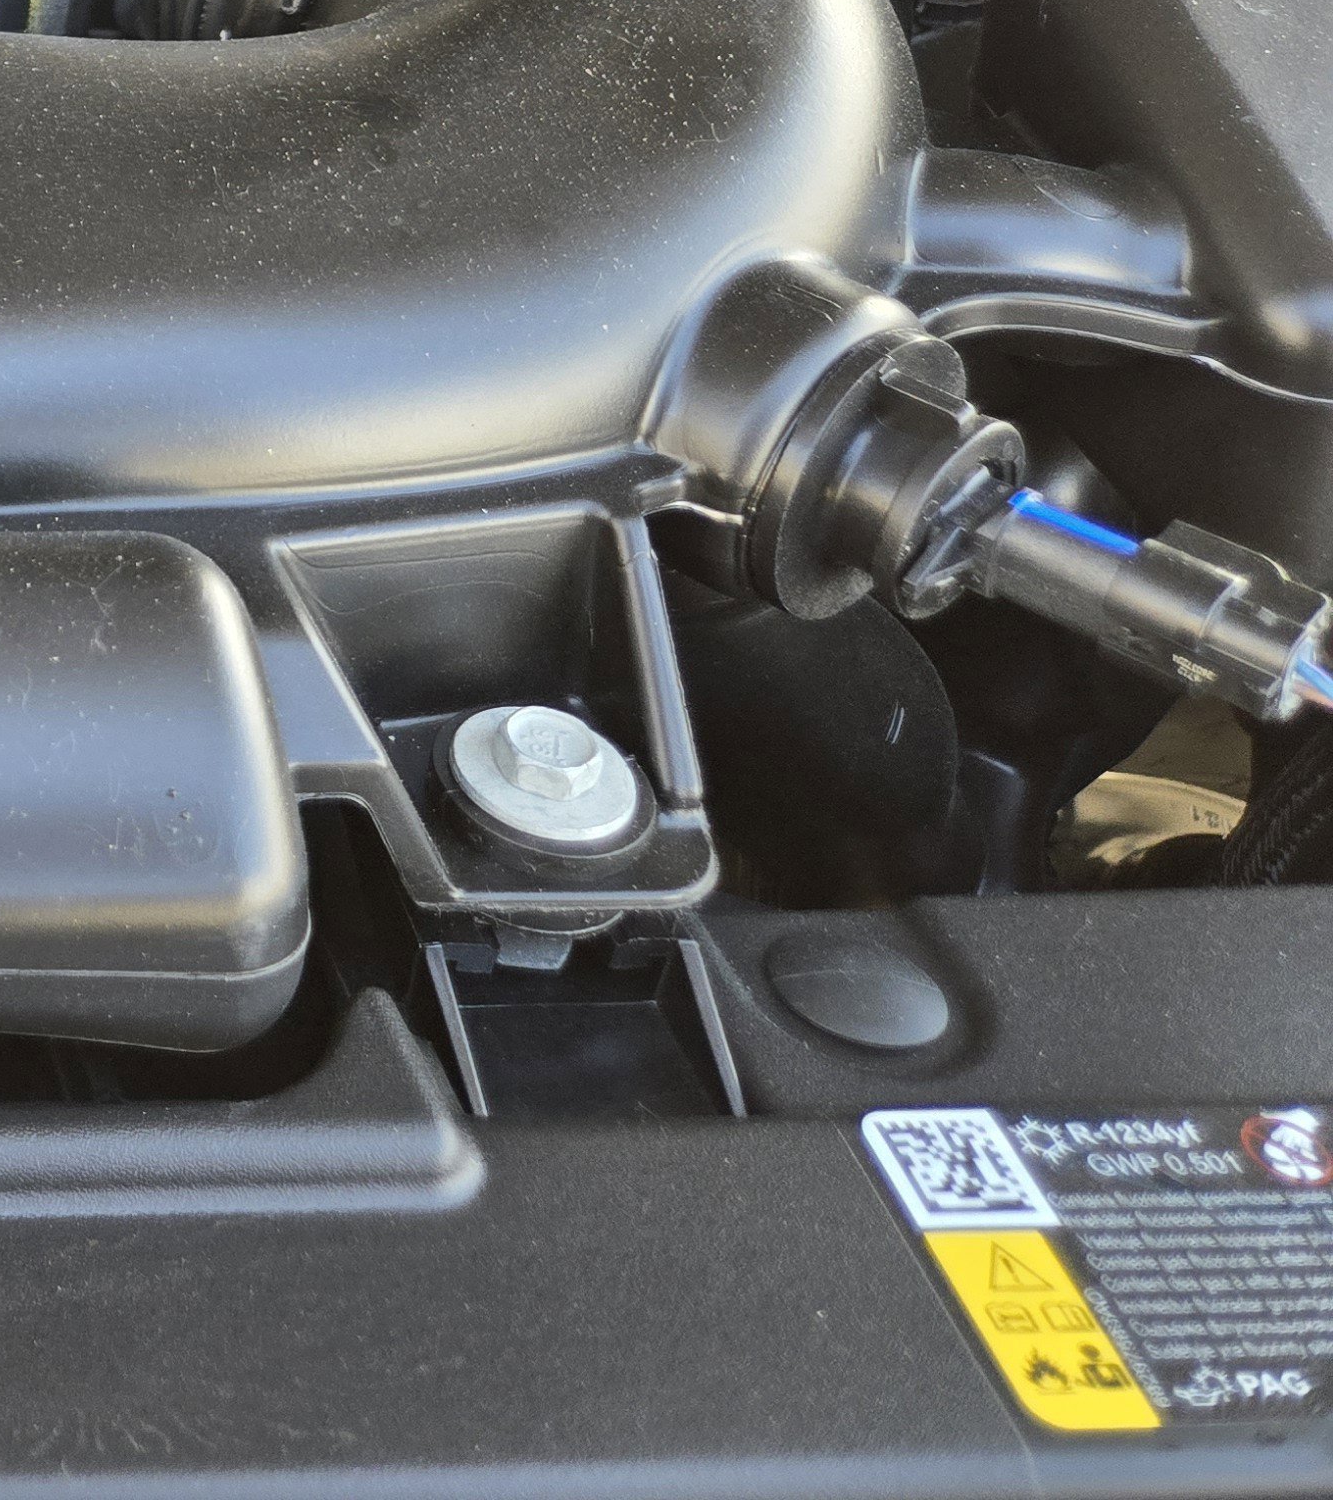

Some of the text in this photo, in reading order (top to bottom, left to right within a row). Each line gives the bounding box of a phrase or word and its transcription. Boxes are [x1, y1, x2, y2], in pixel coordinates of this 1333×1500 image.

[1065, 1120, 1203, 1148] R-1234yf
[1086, 1150, 1244, 1176] GWP 0.501
[1235, 1369, 1312, 1399] PAG
